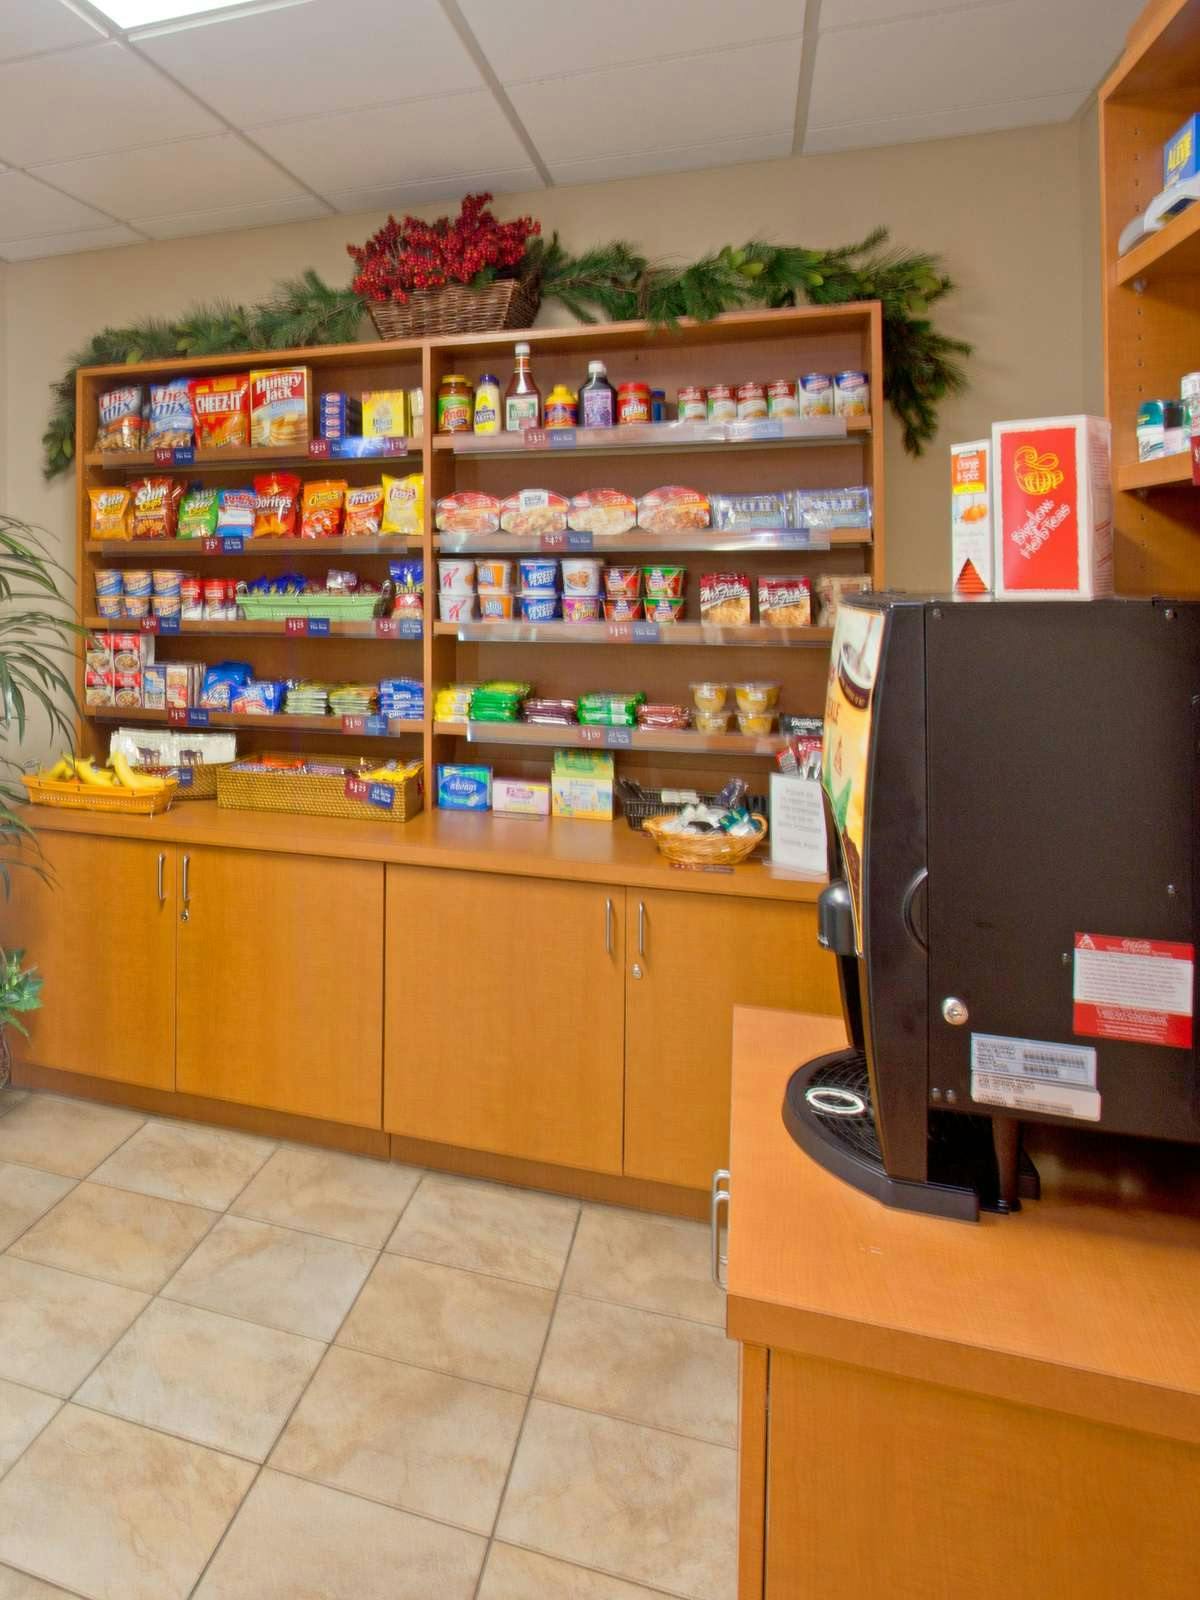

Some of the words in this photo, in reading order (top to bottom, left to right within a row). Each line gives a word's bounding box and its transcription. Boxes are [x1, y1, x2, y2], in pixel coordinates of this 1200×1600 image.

[256, 372, 302, 394] Hungry
[263, 386, 293, 406] Jack
[255, 495, 292, 510] Doritos
